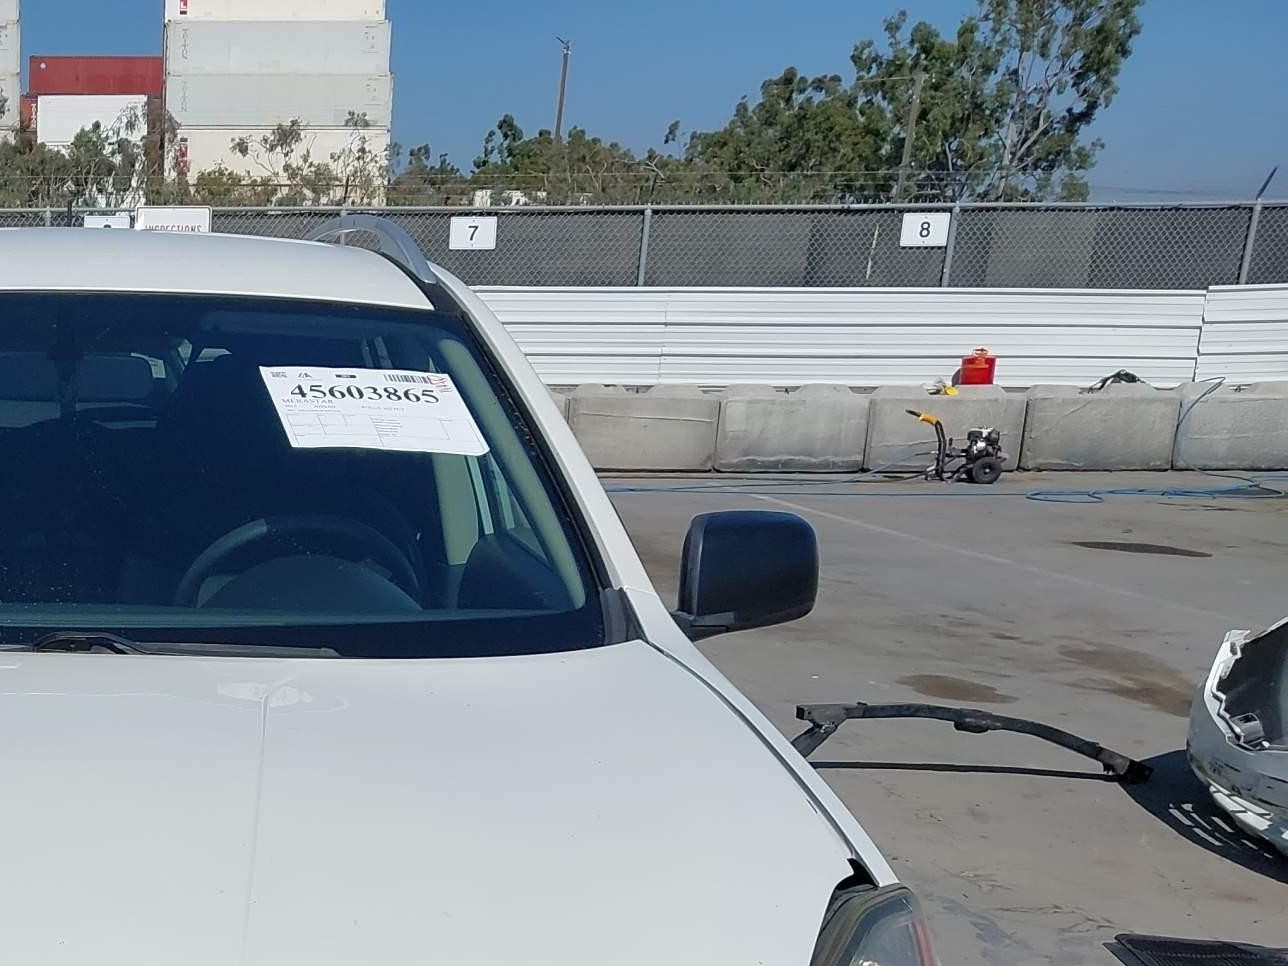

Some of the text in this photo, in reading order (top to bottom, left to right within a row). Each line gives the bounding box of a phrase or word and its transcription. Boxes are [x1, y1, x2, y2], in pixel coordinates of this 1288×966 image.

[468, 225, 479, 241] 7
[919, 221, 930, 238] 8
[290, 383, 440, 404] 45603865
